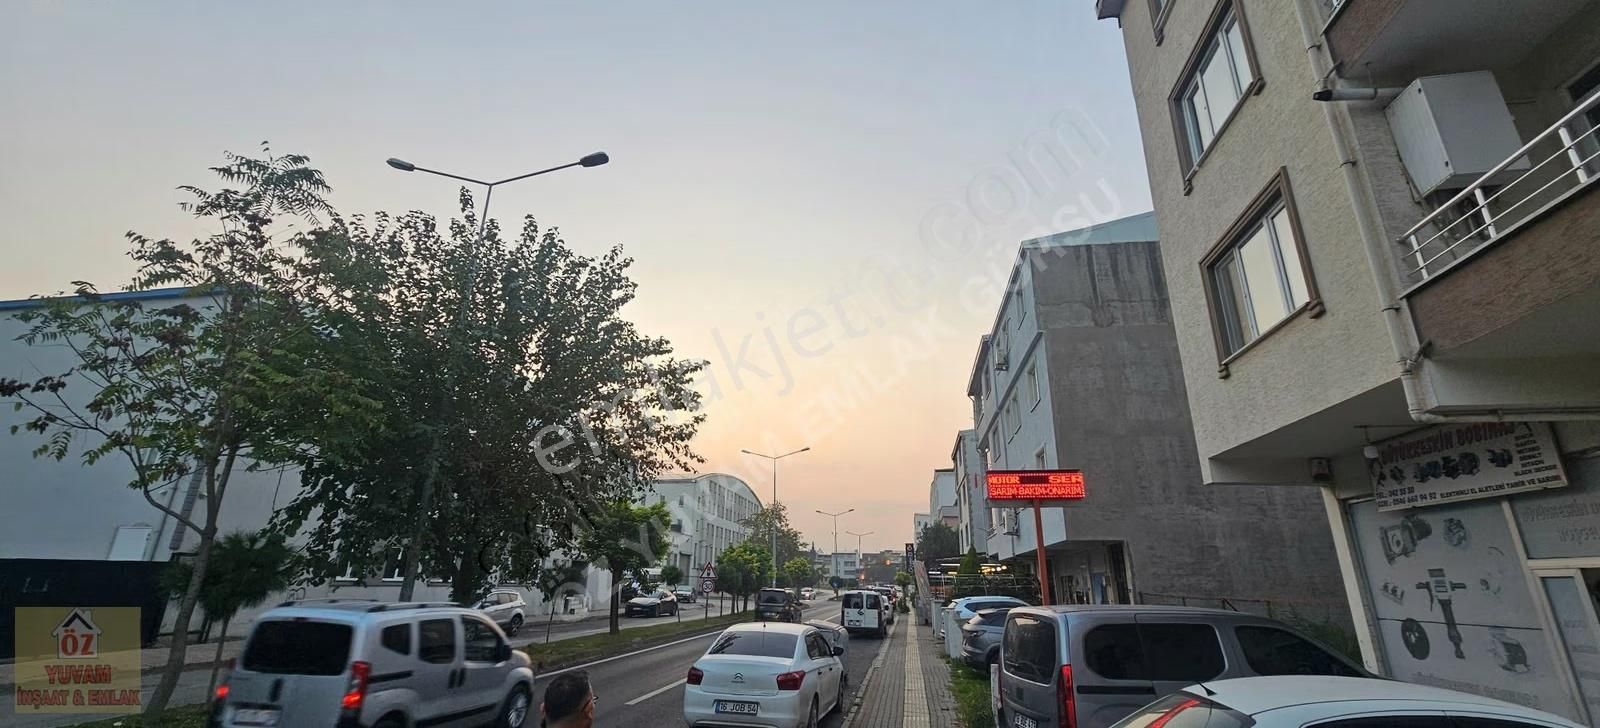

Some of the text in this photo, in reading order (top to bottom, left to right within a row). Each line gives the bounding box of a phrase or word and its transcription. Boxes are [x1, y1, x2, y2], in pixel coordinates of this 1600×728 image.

[987, 475, 1083, 485] MOTOR SER
[1526, 478, 1536, 486] VE
[990, 486, 1082, 496] SARIM-BAKIM-ONARIM
[704, 582, 713, 590] 30
[747, 703, 757, 712] 54
